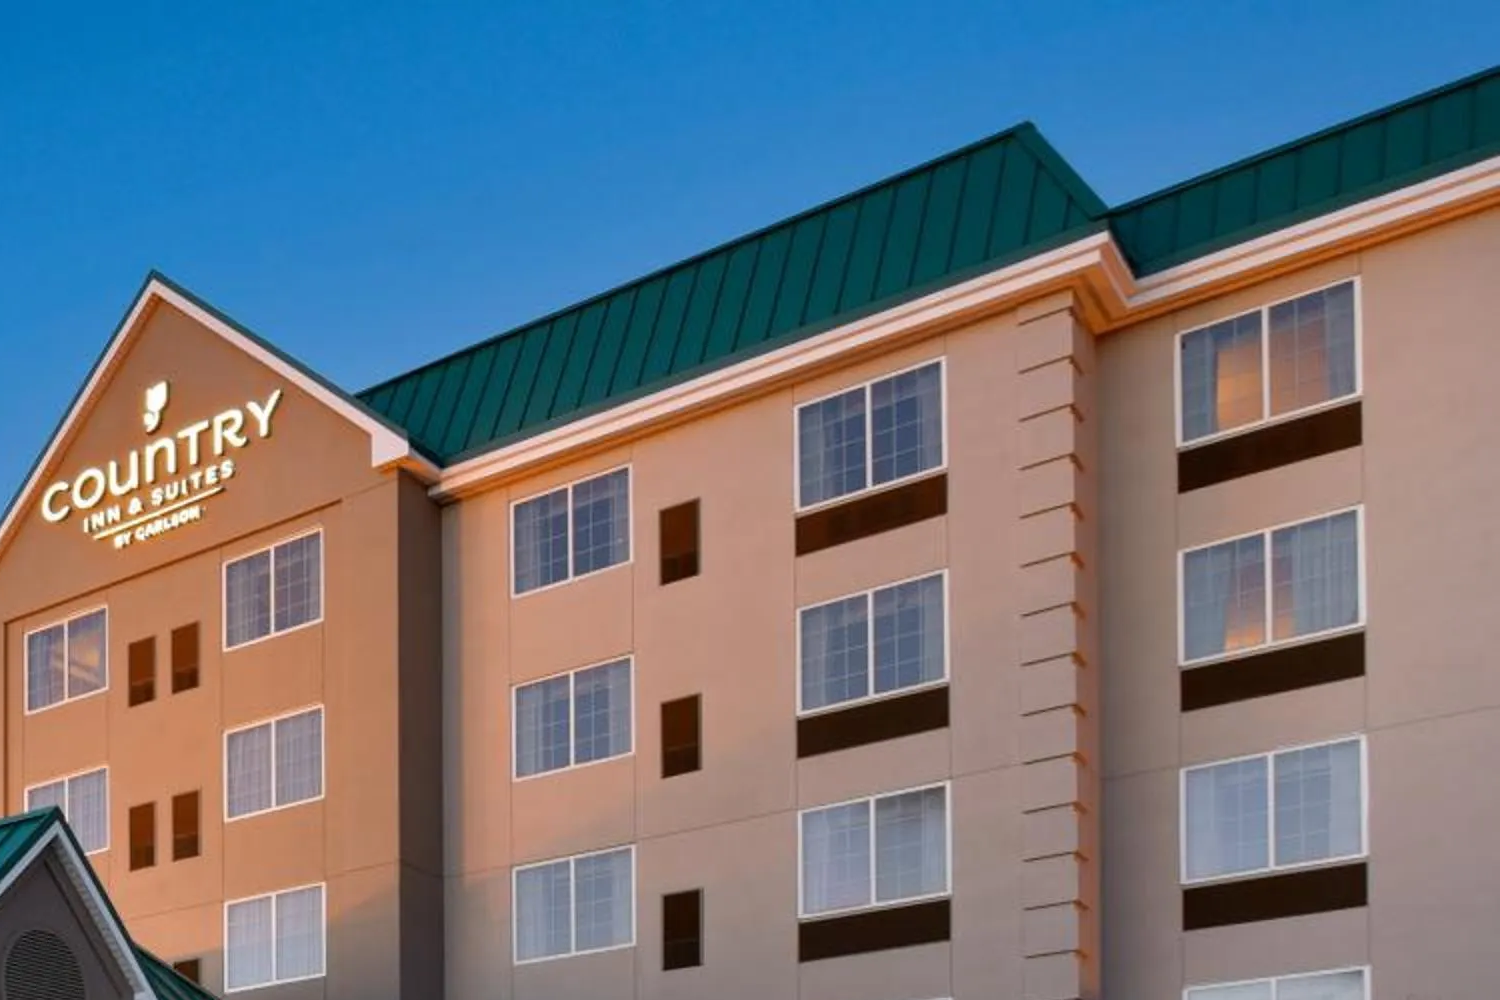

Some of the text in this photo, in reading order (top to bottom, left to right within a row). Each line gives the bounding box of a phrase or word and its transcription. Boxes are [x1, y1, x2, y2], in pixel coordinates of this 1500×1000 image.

[41, 388, 282, 522] COUNTRY
[83, 504, 121, 533] INN
[150, 459, 235, 506] SUITES
